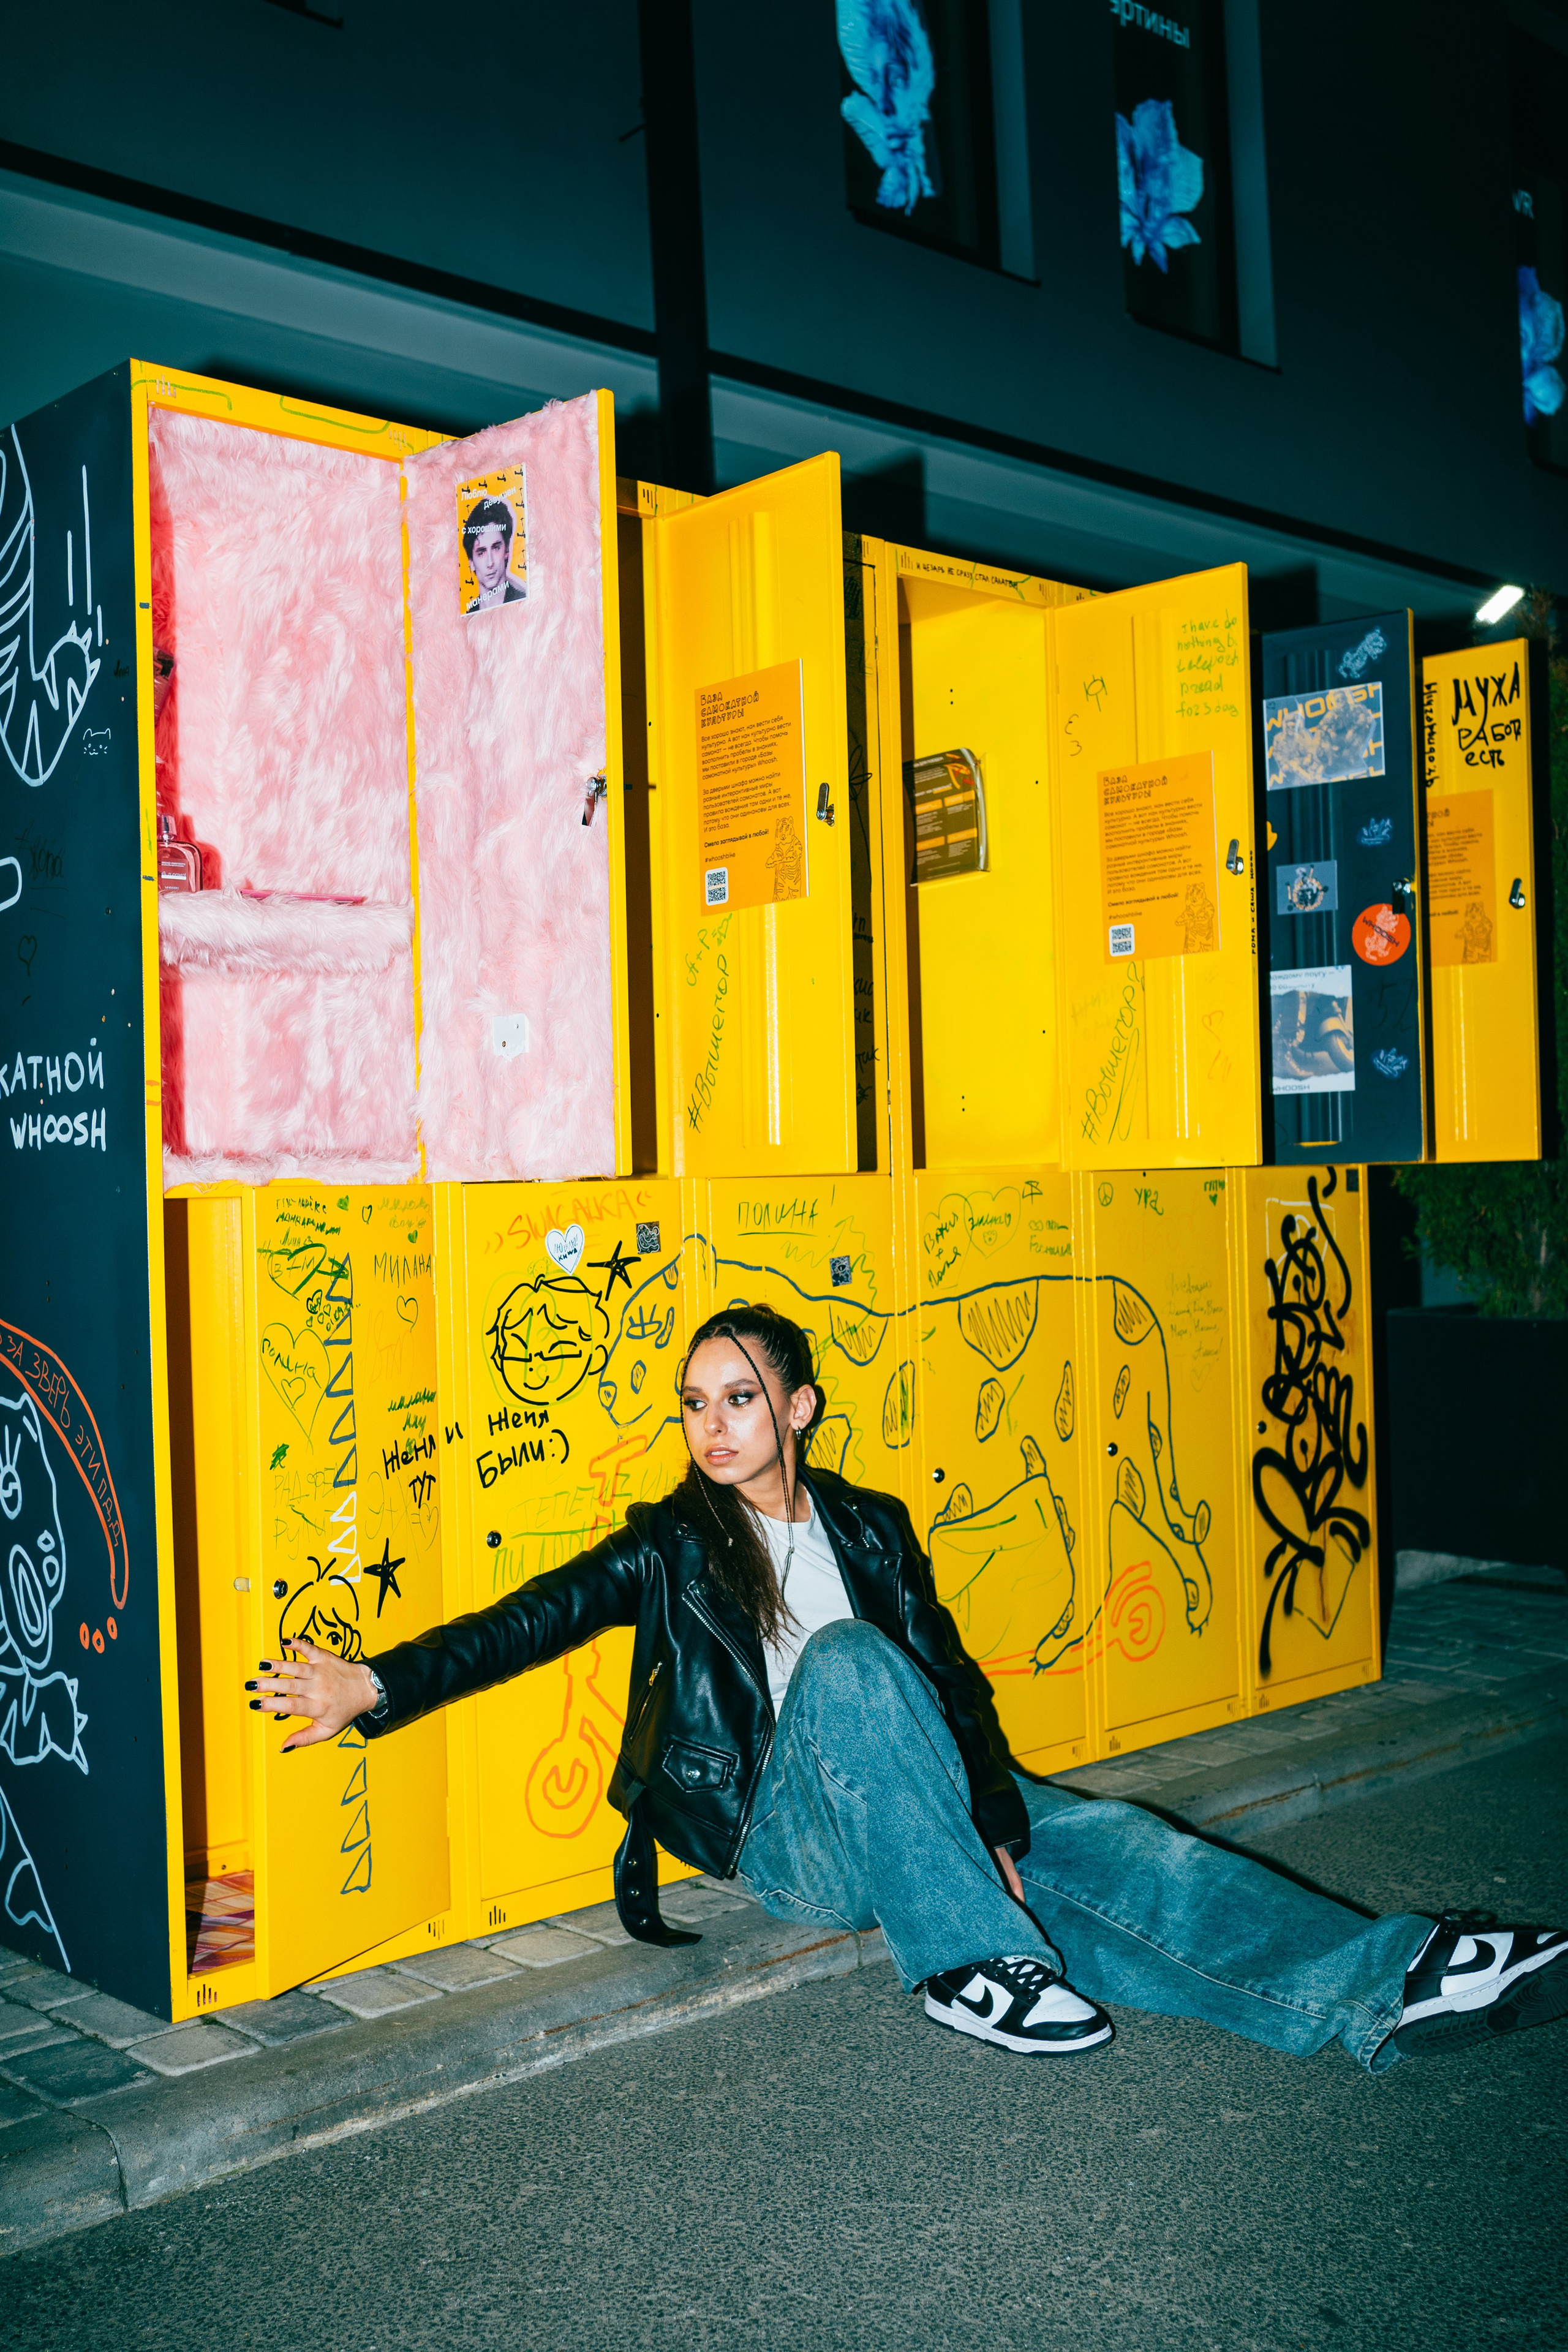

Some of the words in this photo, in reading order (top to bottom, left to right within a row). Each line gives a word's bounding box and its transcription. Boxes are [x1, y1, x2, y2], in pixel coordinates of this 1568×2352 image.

[461, 488, 488, 501] Люблю
[483, 486, 516, 510] девушек
[467, 524, 507, 536] хорошими
[466, 579, 510, 610] манерами
[701, 692, 723, 706] БАЗА
[701, 692, 759, 717] САМОКАТНОЙ
[1452, 662, 1520, 738] МУХА
[701, 708, 744, 728] КУЛЬТУРЫ
[701, 739, 726, 750] культурно.
[751, 726, 776, 737] культурно
[711, 731, 729, 739] хорошо
[729, 726, 745, 735] знают,
[701, 748, 722, 758] самокат
[734, 741, 752, 749] всегда.
[702, 755, 729, 765] восполнить
[730, 748, 752, 758] пробелы
[756, 742, 778, 751] знаниях,
[702, 767, 731, 780] самокатной
[732, 763, 756, 773] культуры»
[757, 756, 778, 766] Whoosh.
[710, 760, 735, 770] поставили
[703, 794, 720, 804] разные
[722, 785, 758, 798] интерактивные
[710, 785, 730, 794] дверьми
[703, 796, 739, 810] пользователей
[740, 791, 766, 802] самокатов.
[703, 809, 724, 818] правила
[725, 803, 748, 813] вождения
[740, 807, 767, 817] одинаковы
[720, 833, 748, 845] заглядывай
[752, 829, 769, 837] любой!
[705, 852, 736, 862] #whooshbike
[1271, 973, 1303, 981] аждому
[10, 1107, 107, 1152] WHOOSH
[374, 1251, 432, 1289] МИЛАНА
[7, 1335, 24, 1367] ЗА
[24, 1352, 71, 1429] ЗВЕРЬ
[382, 1434, 437, 1480] Женя
[488, 1406, 550, 1436] Женя
